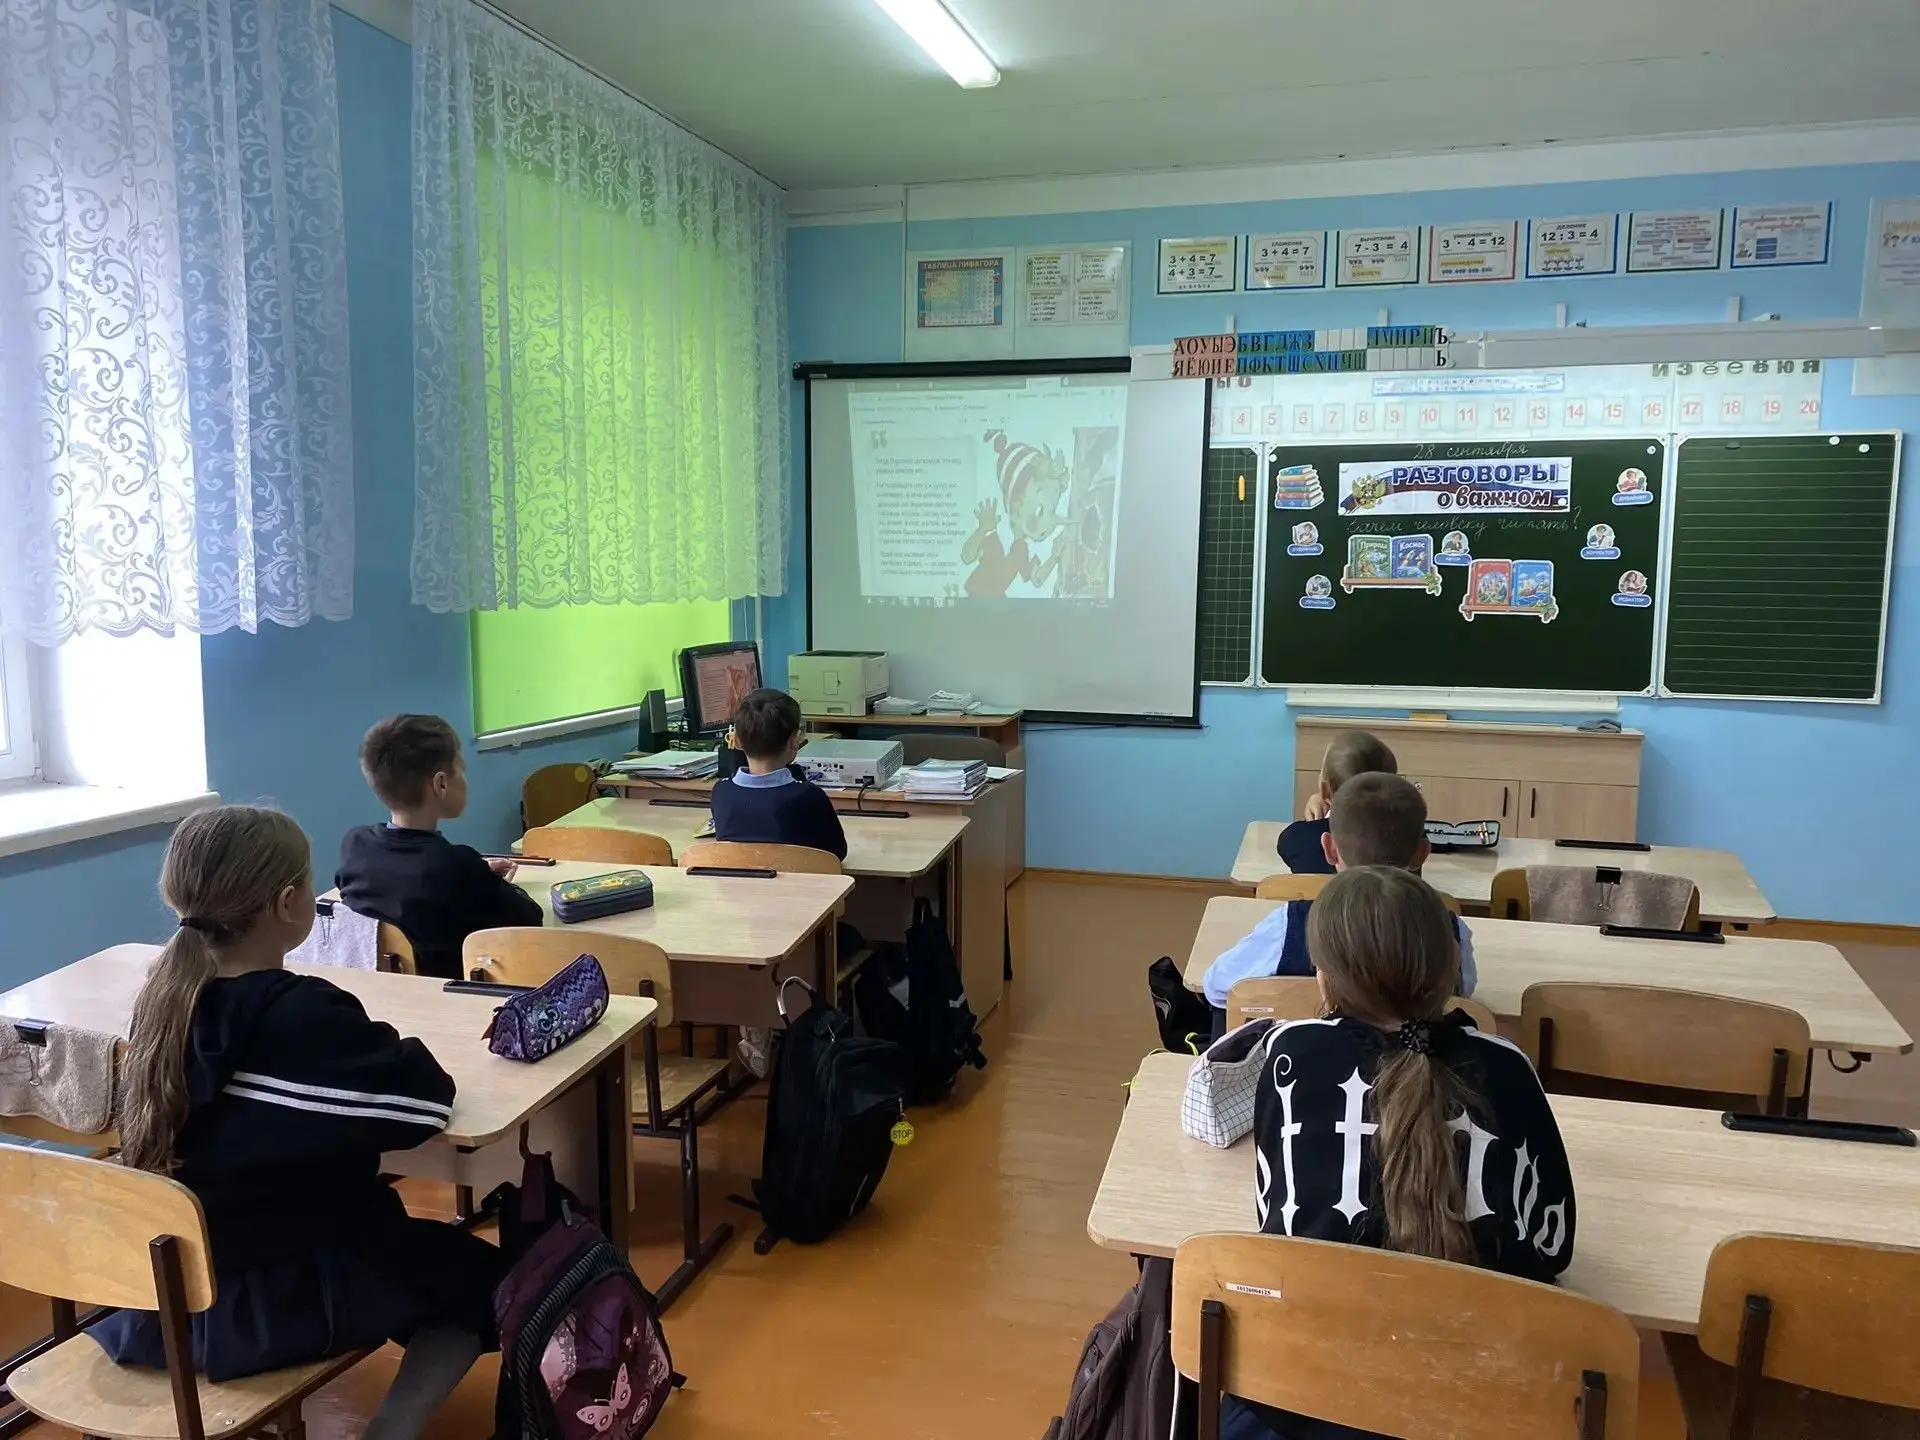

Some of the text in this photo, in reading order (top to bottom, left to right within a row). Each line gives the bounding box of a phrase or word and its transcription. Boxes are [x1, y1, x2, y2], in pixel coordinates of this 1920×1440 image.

[1541, 232, 1556, 241] 12
[1568, 231, 1575, 240] 3
[1590, 229, 1598, 238] 4
[1354, 244, 1362, 253] 7
[1372, 243, 1380, 252] 3
[1400, 240, 1408, 250] 4
[1443, 239, 1450, 249] 3
[1468, 238, 1475, 247] 4
[1491, 236, 1505, 246] 12
[1169, 255, 1177, 264] 3
[1189, 254, 1196, 263] 4
[1209, 253, 1216, 262] 7
[1261, 248, 1269, 258] 3
[1281, 247, 1289, 256] 4
[1303, 246, 1310, 255] 7
[1168, 268, 1176, 277] 4
[1188, 267, 1195, 276] 3
[1208, 266, 1215, 276] 7
[1237, 400, 1819, 426] 4 5 6 7 8 9 10 11 12 13 14 15 16 17 18 19 20
[1413, 441, 1529, 460] 28 сентября
[1392, 464, 1558, 486] РАЗГОВОРЫ
[1437, 486, 1552, 508] о важном
[892, 1128, 912, 1140] STOP
